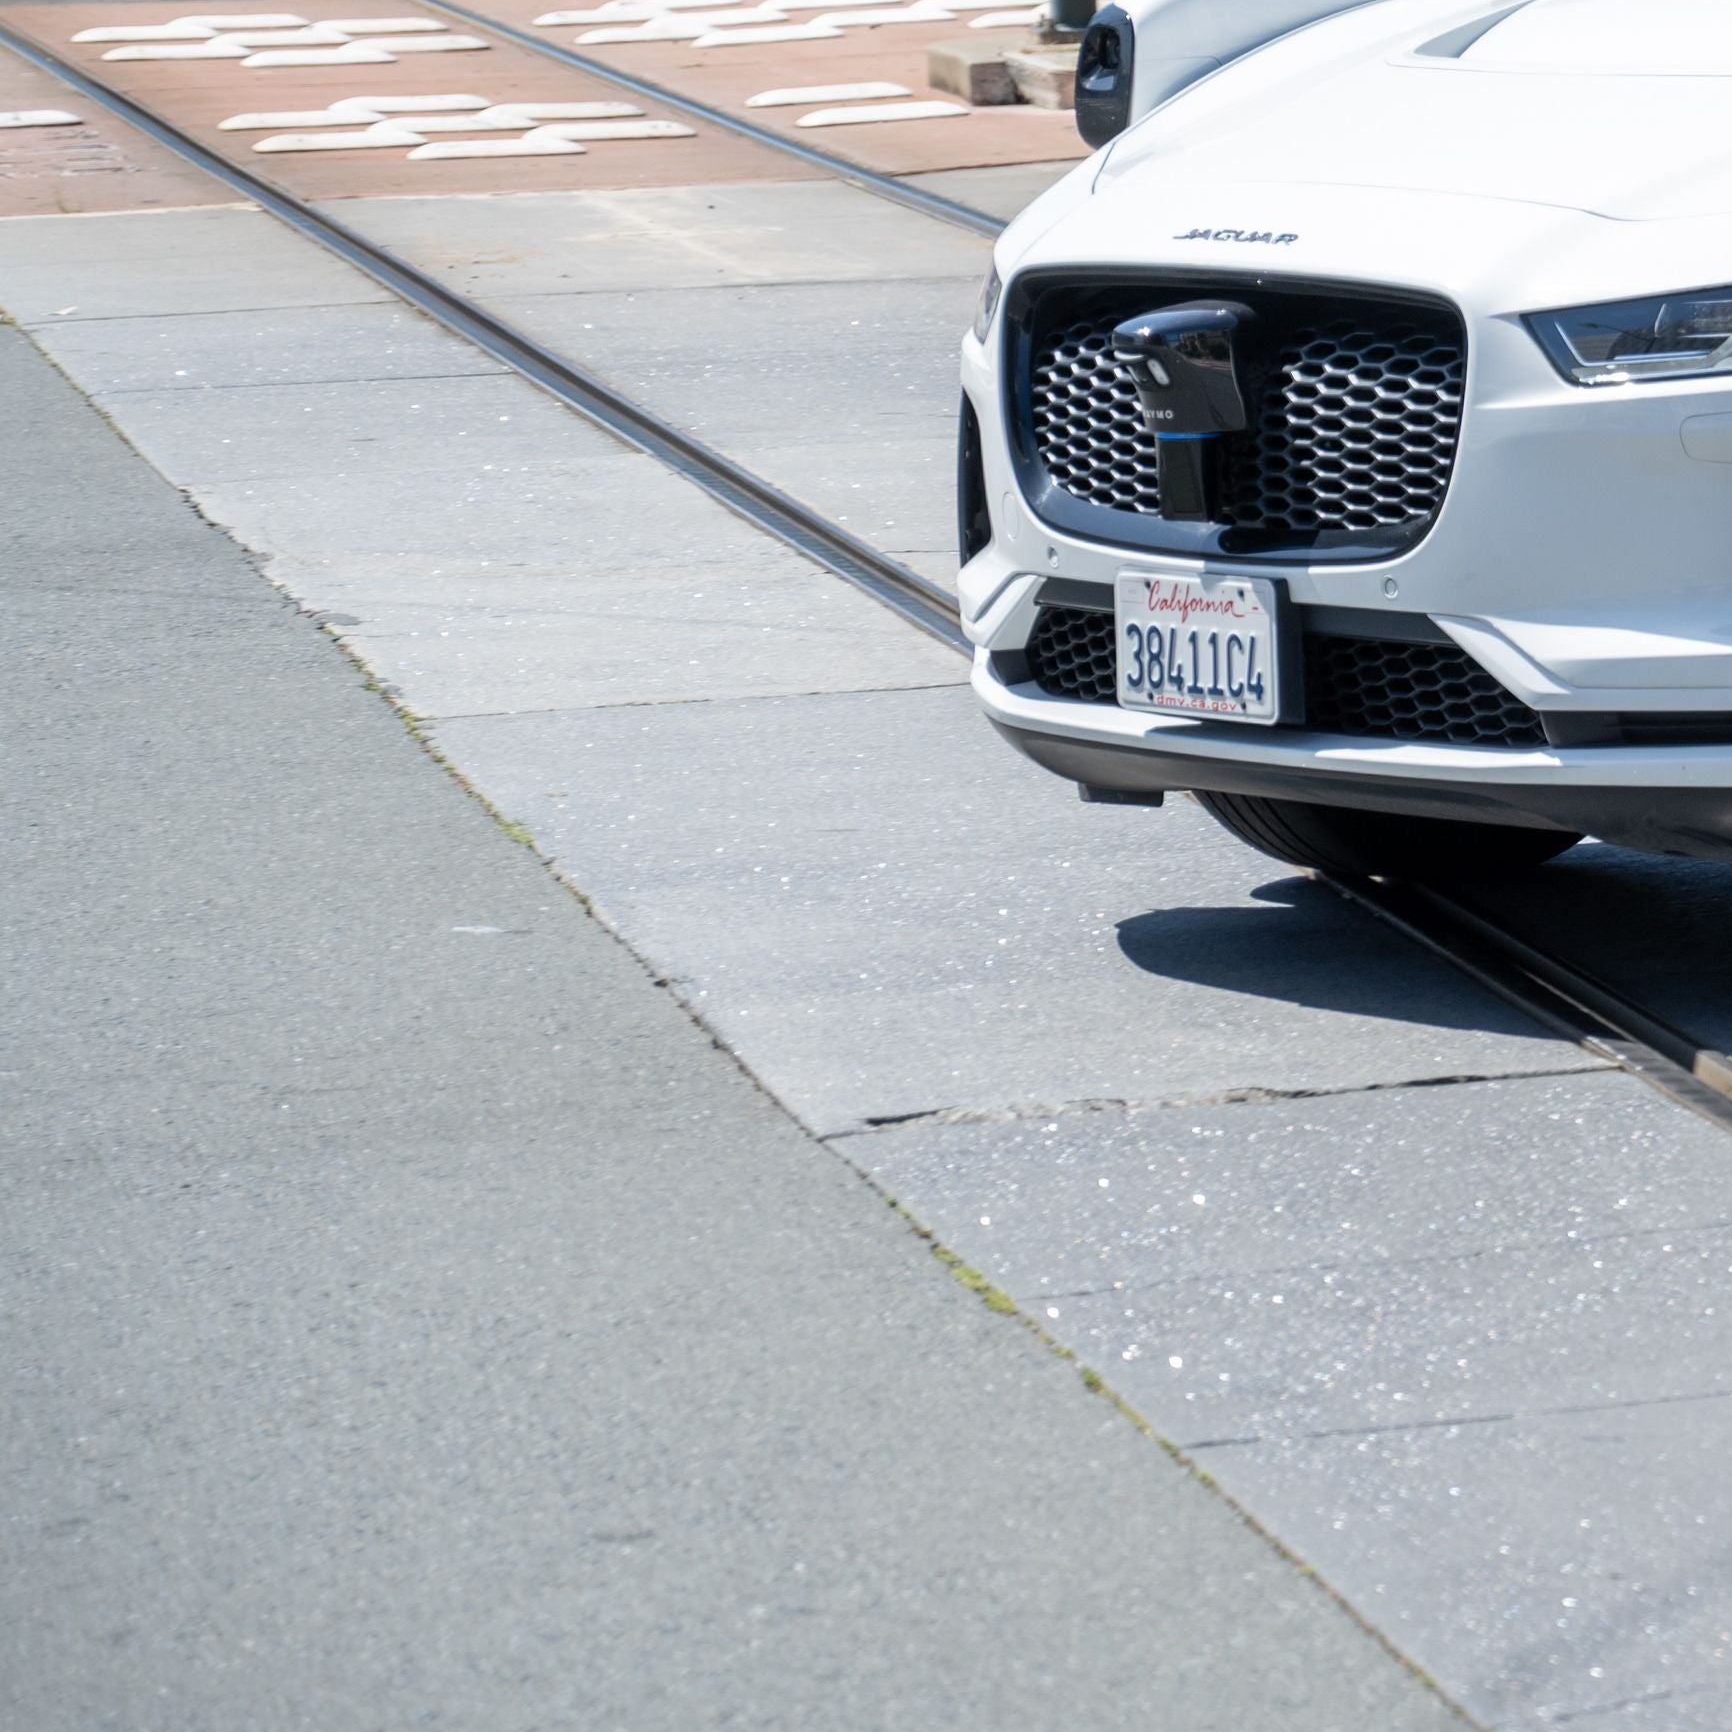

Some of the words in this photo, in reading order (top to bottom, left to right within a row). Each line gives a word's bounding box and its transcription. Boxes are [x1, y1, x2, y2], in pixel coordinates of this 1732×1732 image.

[1173, 228, 1299, 245] JAGUAR
[1148, 580, 1245, 623] California
[1126, 623, 1264, 701] 38411C4
[1156, 694, 1237, 712] dmv.ca.gov
